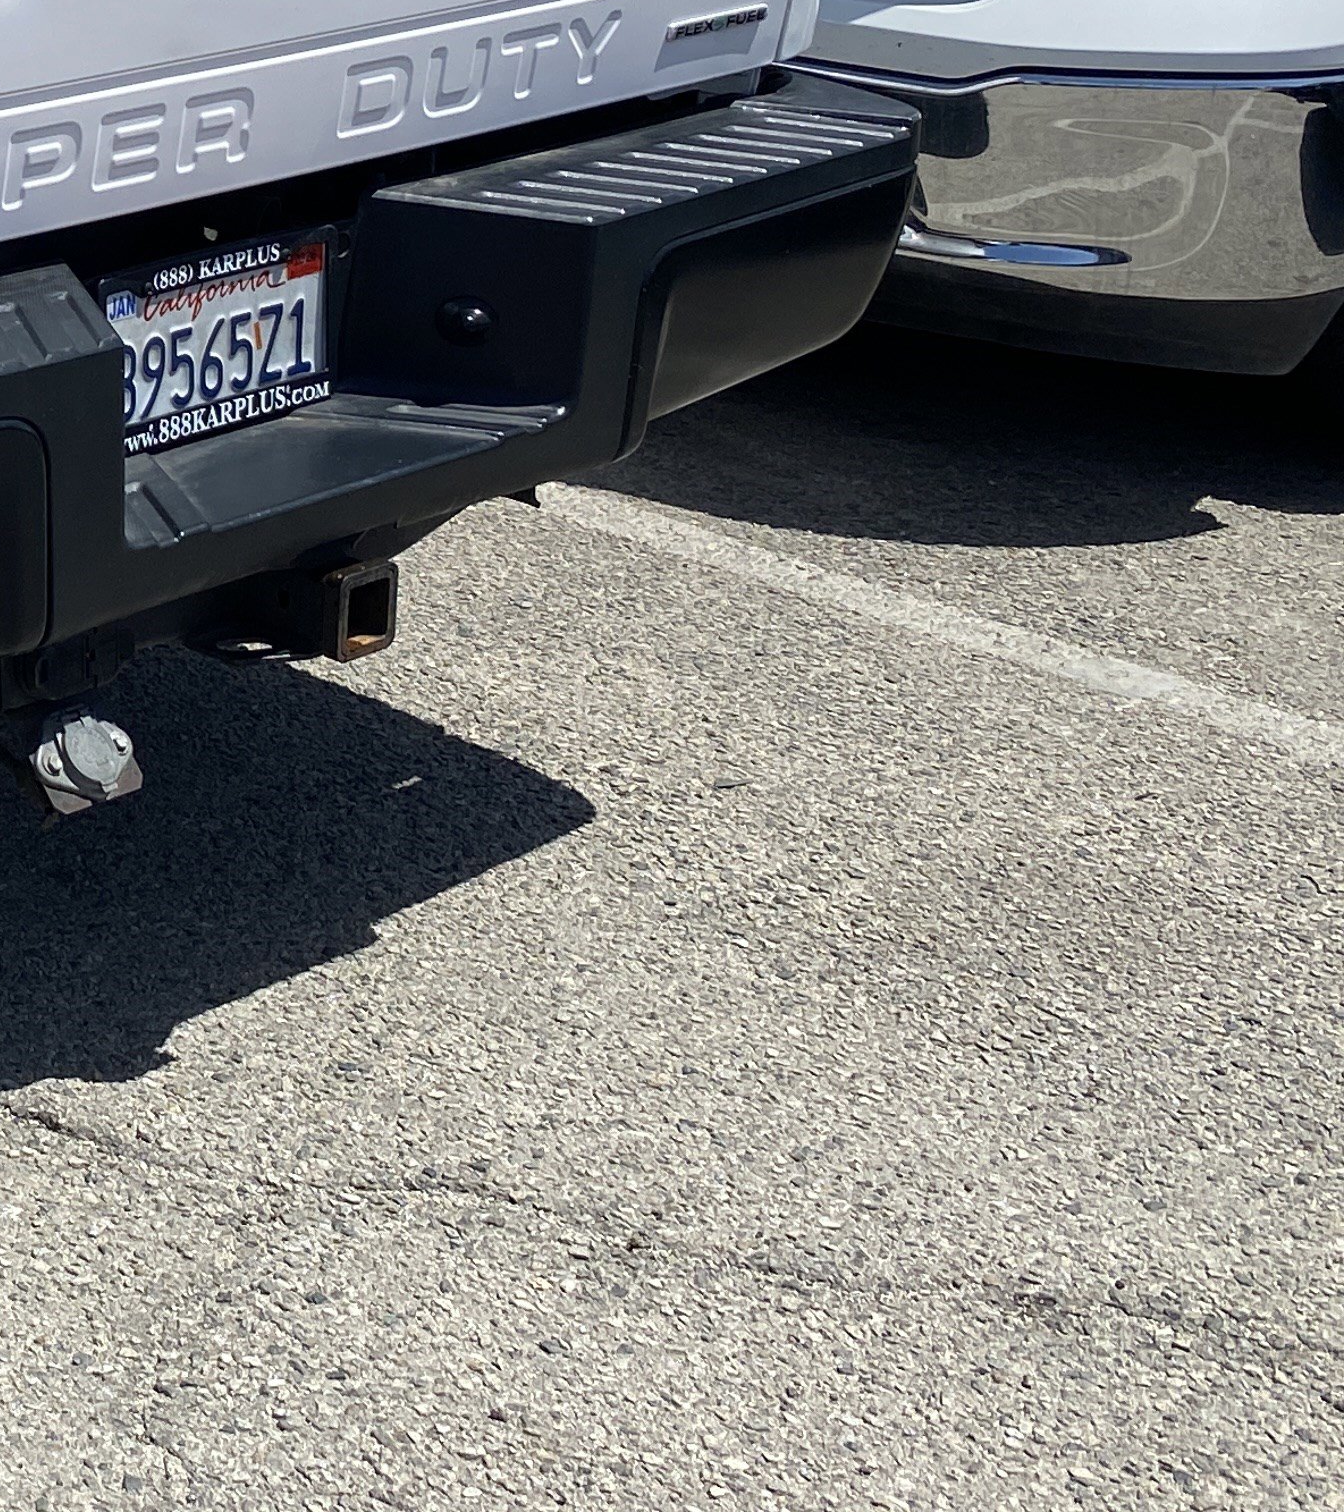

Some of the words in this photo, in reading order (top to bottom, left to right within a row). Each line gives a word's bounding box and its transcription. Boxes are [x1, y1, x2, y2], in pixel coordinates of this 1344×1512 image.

[675, 19, 715, 40] FLEX
[725, 8, 767, 28] FUEL
[336, 9, 623, 139] DUTY
[153, 262, 194, 292] (888)
[197, 242, 282, 280] KARPLUS
[108, 294, 136, 320] JAN
[142, 268, 286, 322] California
